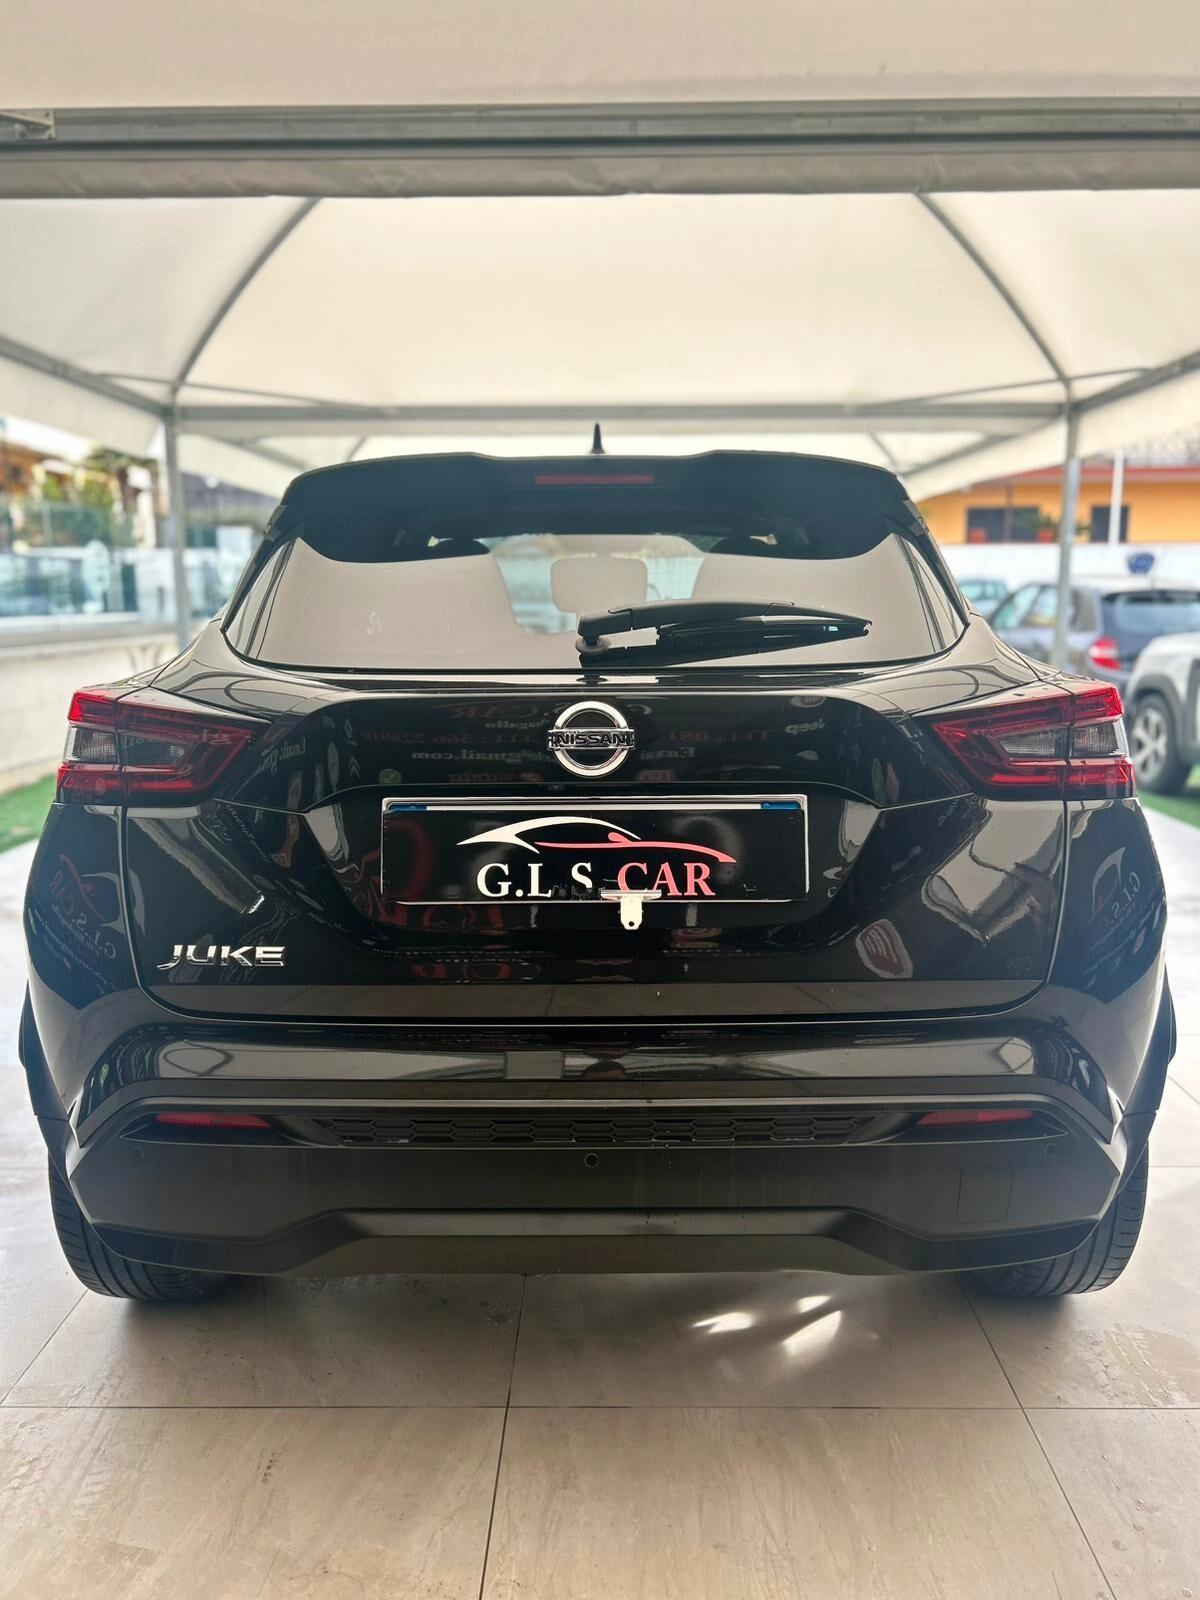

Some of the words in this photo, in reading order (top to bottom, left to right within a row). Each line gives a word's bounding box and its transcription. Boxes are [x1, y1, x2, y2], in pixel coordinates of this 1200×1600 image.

[554, 731, 631, 747] NISSAN
[616, 861, 716, 897] CAR
[156, 943, 286, 970] JUKE
